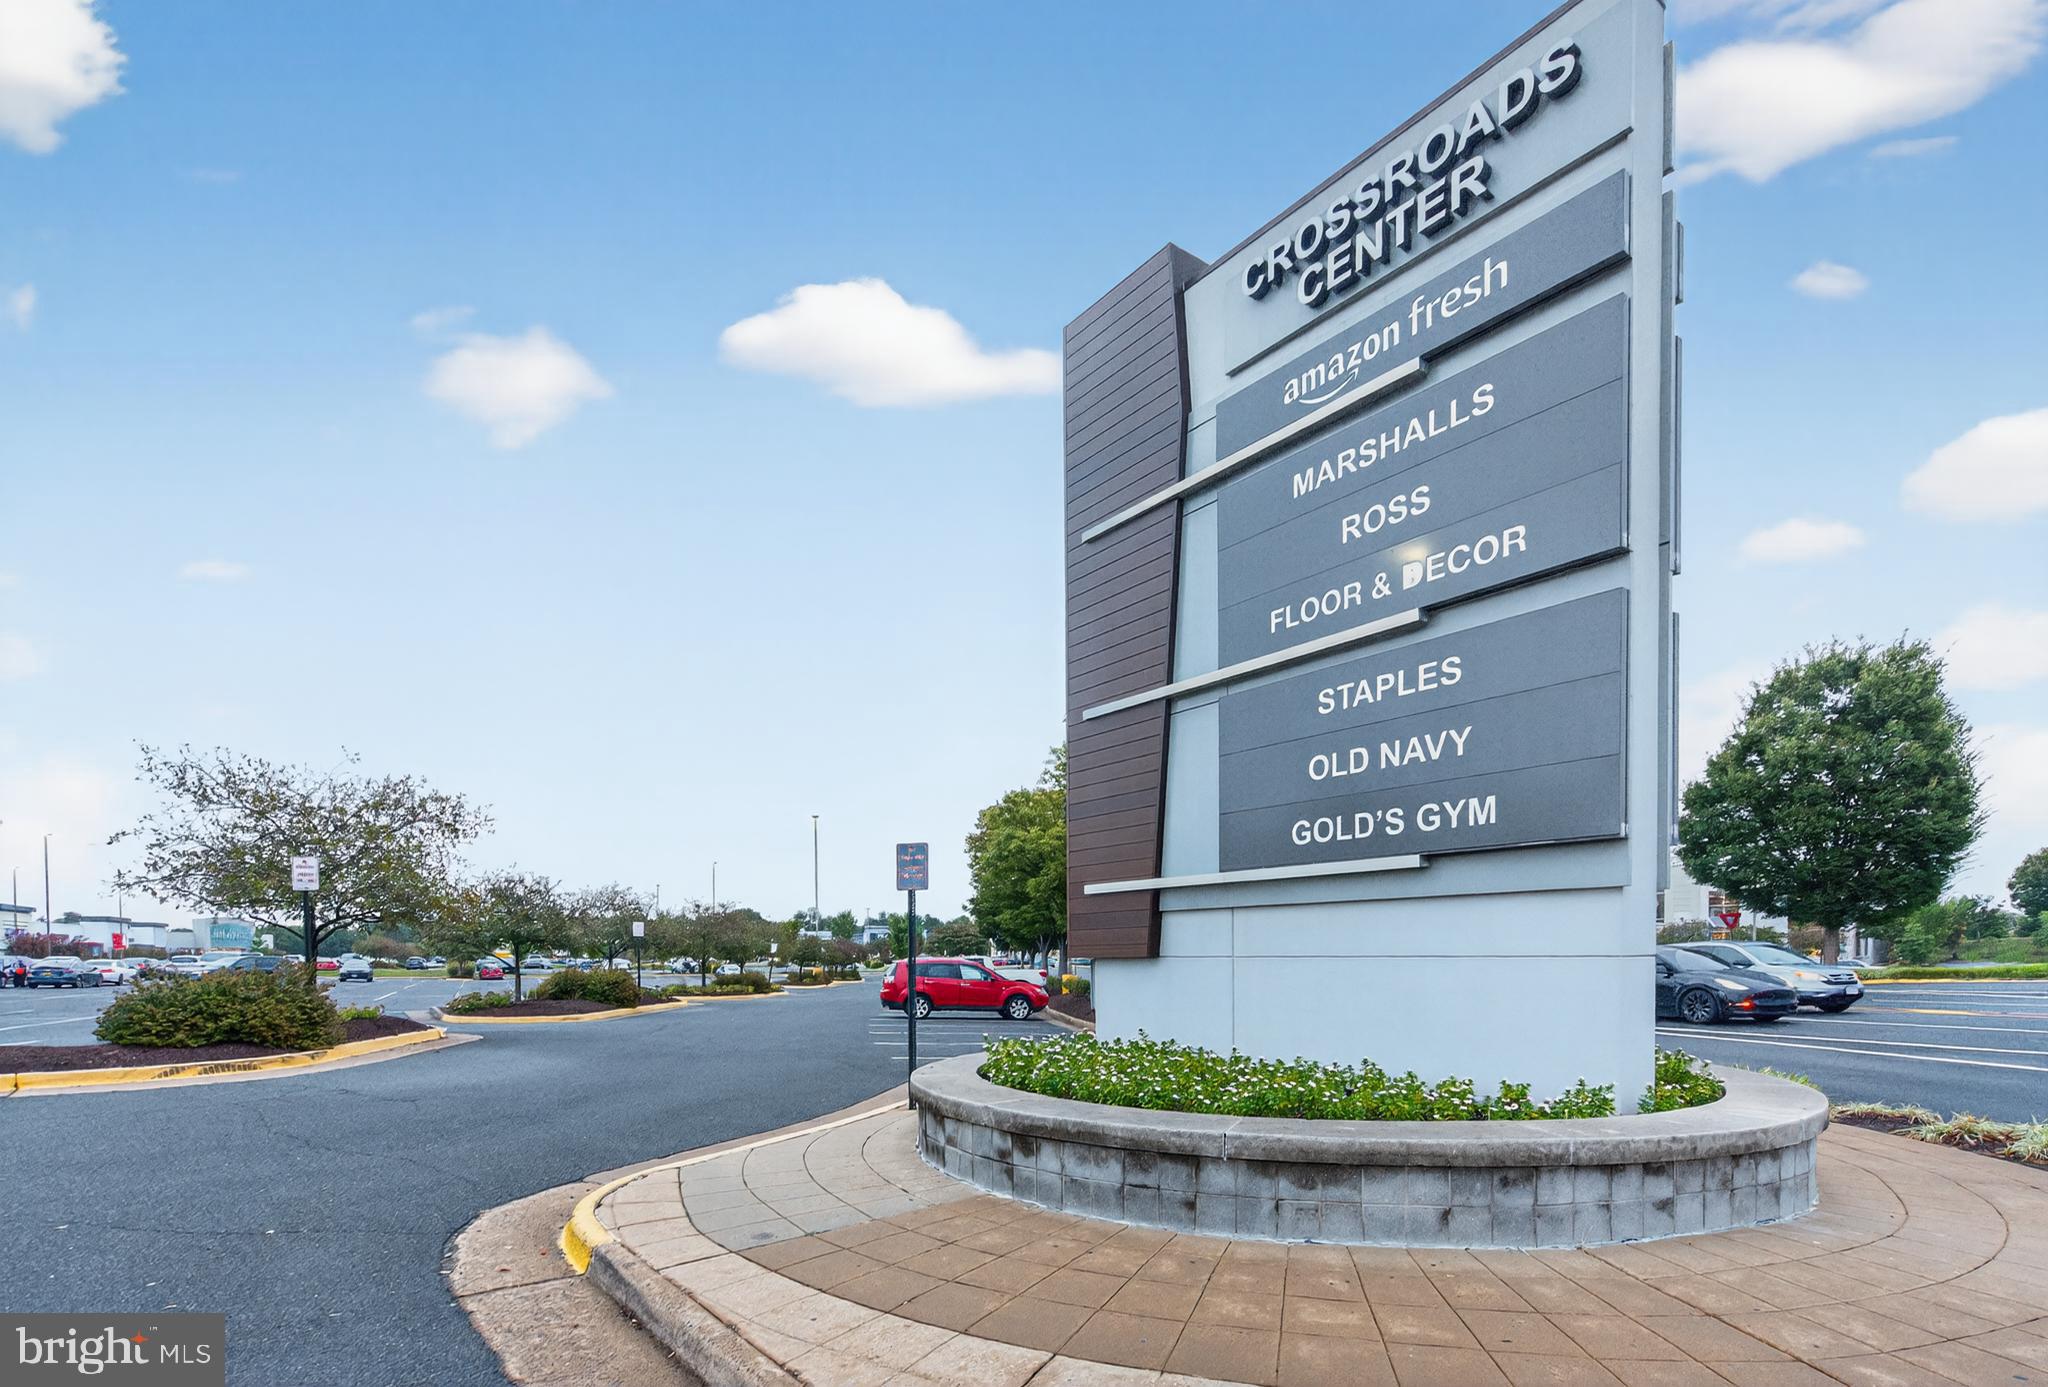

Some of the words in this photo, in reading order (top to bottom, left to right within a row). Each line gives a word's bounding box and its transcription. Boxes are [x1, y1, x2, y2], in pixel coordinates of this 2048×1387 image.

[1241, 37, 1581, 299] CROSSROADS
[1297, 156, 1493, 308] CENTER
[1283, 320, 1400, 405] amazon
[1408, 257, 1509, 336] fresh
[1293, 383, 1495, 498] MARSHALLS
[1342, 485, 1431, 543] ROSS
[1270, 582, 1362, 633] FLOOR
[1372, 572, 1392, 600] &
[1402, 525, 1527, 590] DECOR
[1318, 656, 1462, 715] STAPLES
[1308, 747, 1369, 781] OLD
[1380, 726, 1473, 769] NAVY
[1291, 808, 1405, 846] GOLD'S
[1416, 795, 1496, 832] GYM
